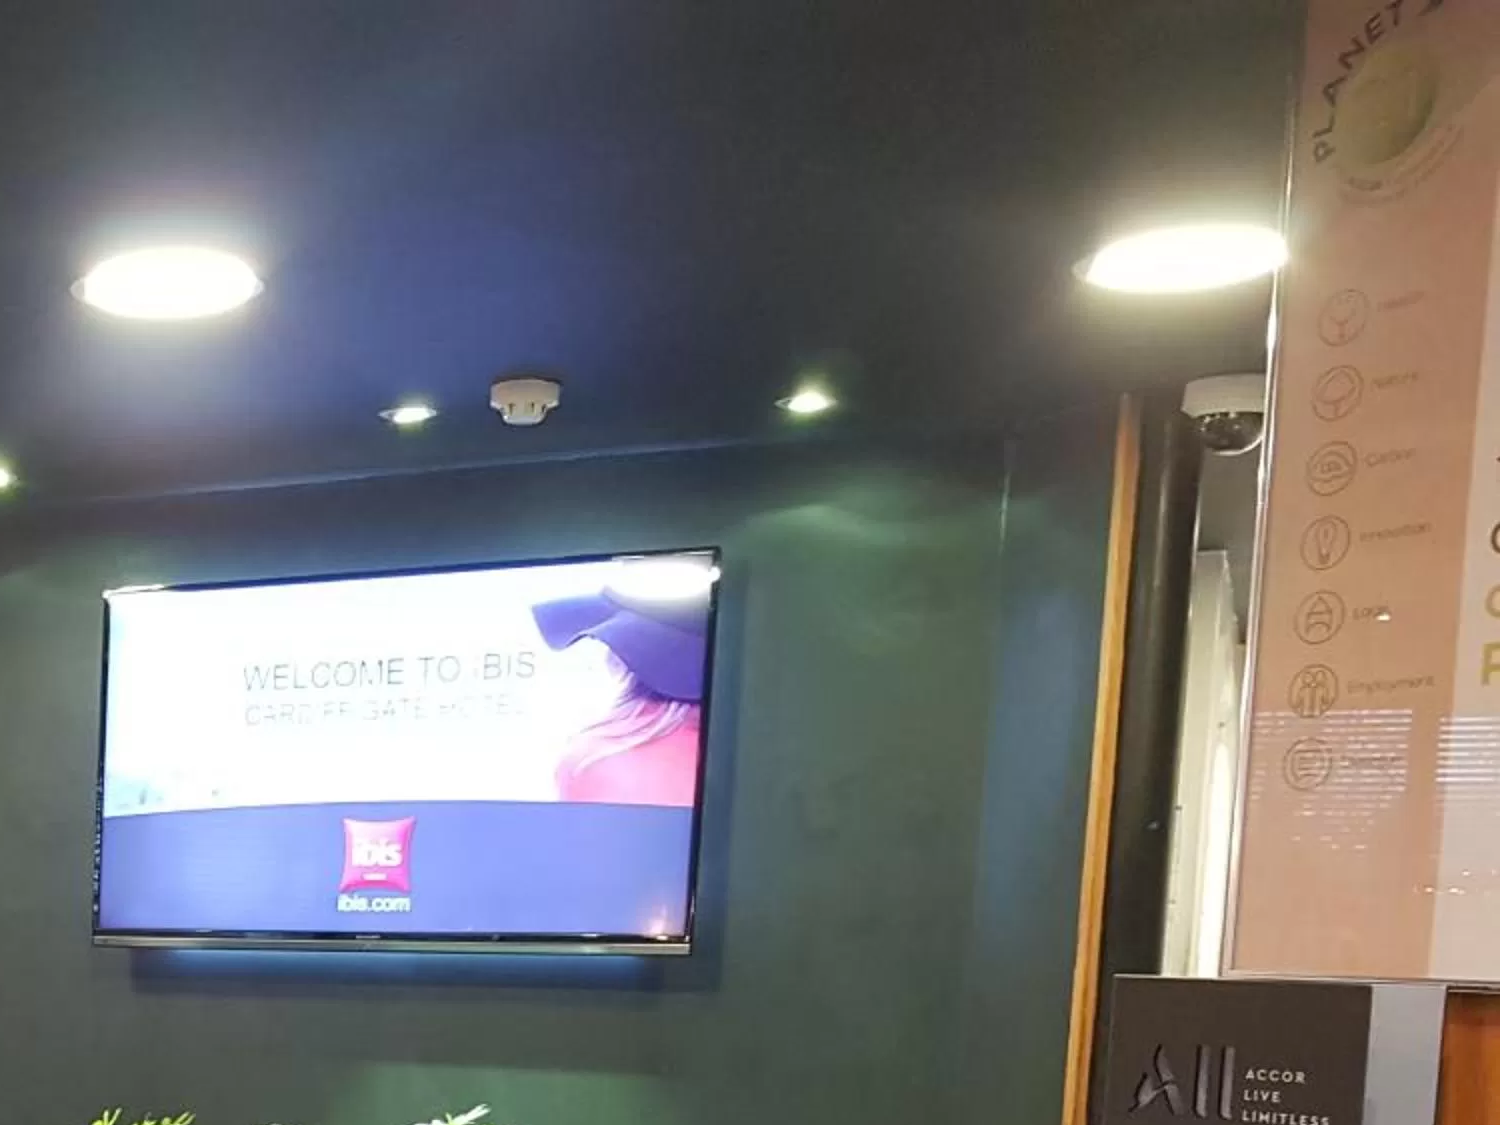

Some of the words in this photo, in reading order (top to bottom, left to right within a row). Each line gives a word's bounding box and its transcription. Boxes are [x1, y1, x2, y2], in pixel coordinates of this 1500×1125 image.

[243, 657, 405, 691] WELCOME
[416, 655, 461, 688] TO
[337, 891, 412, 913] ibis.com
[1127, 1043, 1237, 1120] All
[1245, 1068, 1306, 1085] ACCOR
[1243, 1089, 1281, 1103] LIVE
